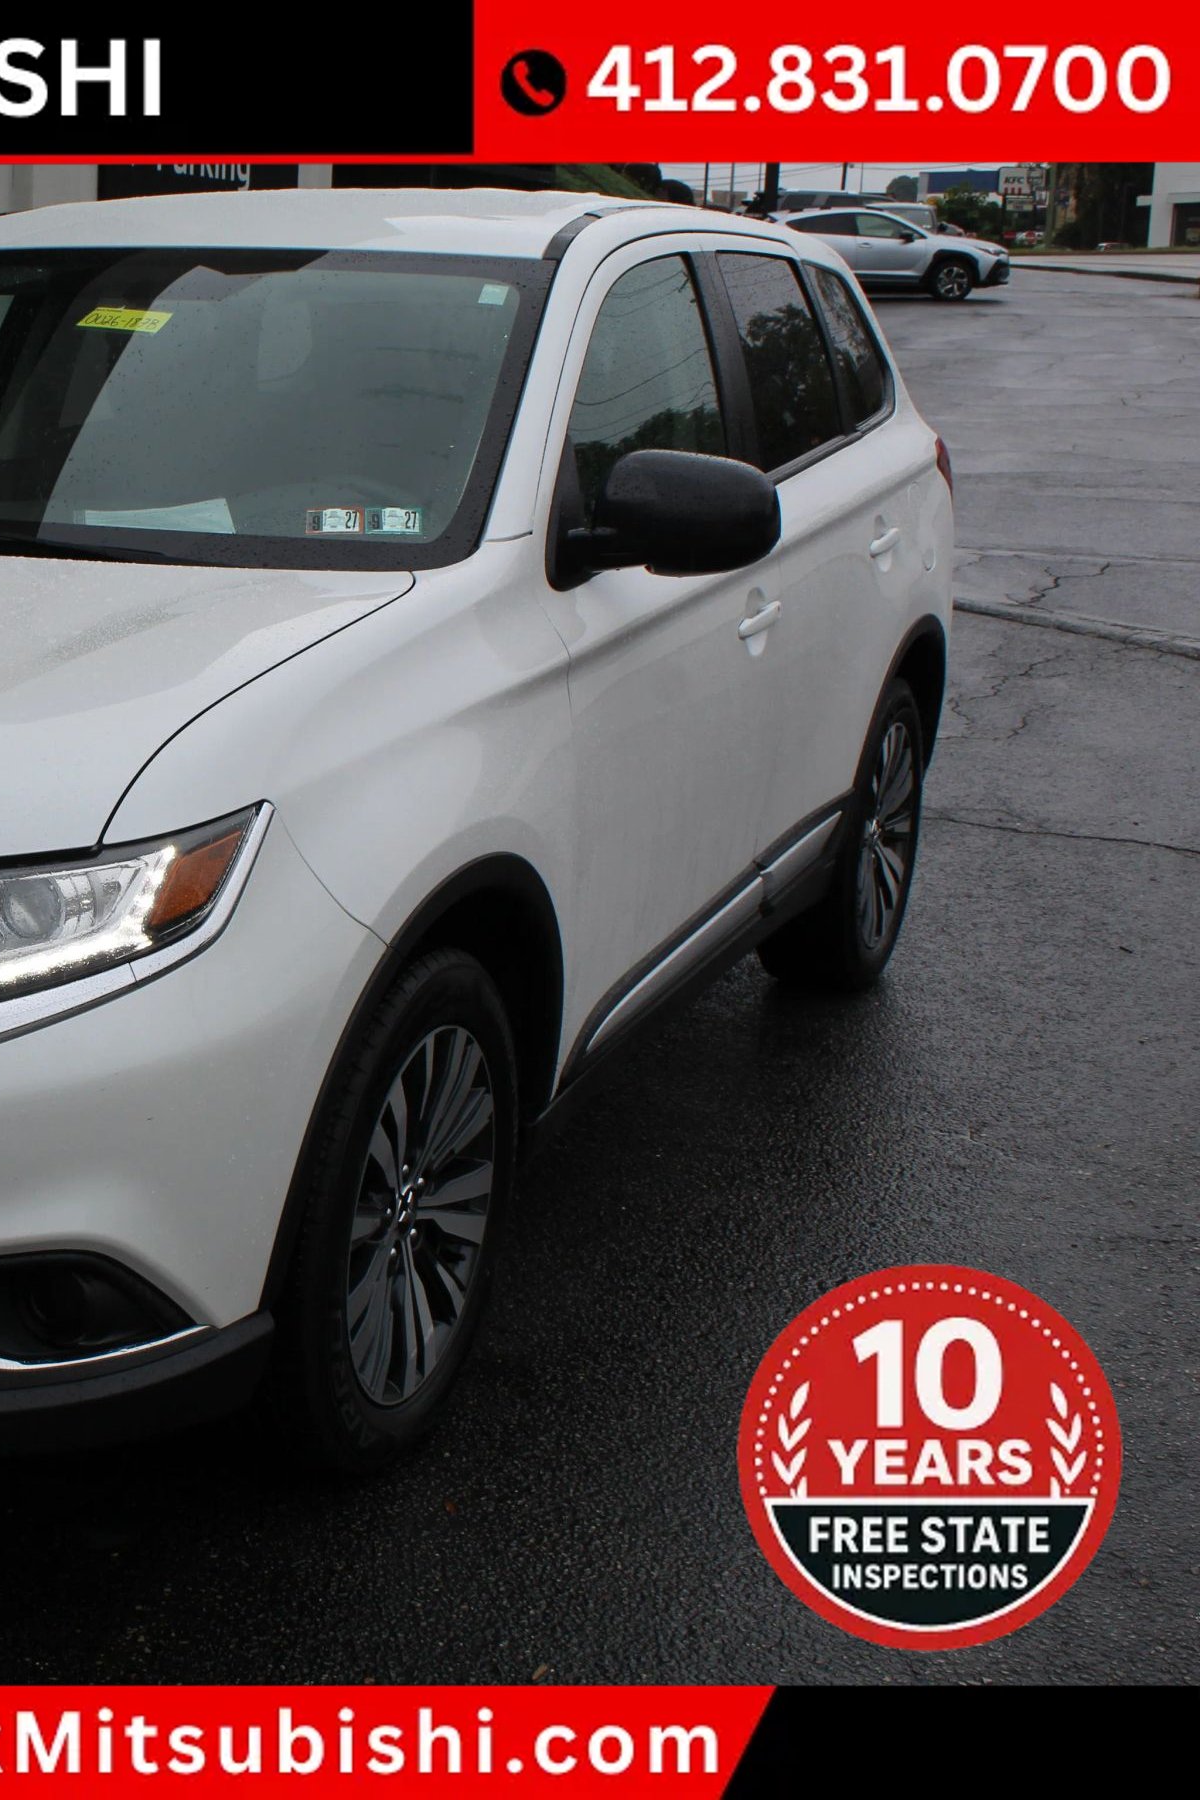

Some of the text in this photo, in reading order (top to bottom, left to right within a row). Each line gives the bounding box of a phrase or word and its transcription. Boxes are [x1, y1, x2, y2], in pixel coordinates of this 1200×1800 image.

[1004, 176, 1025, 185] KFC
[345, 511, 358, 529] 27
[404, 511, 417, 529] 27
